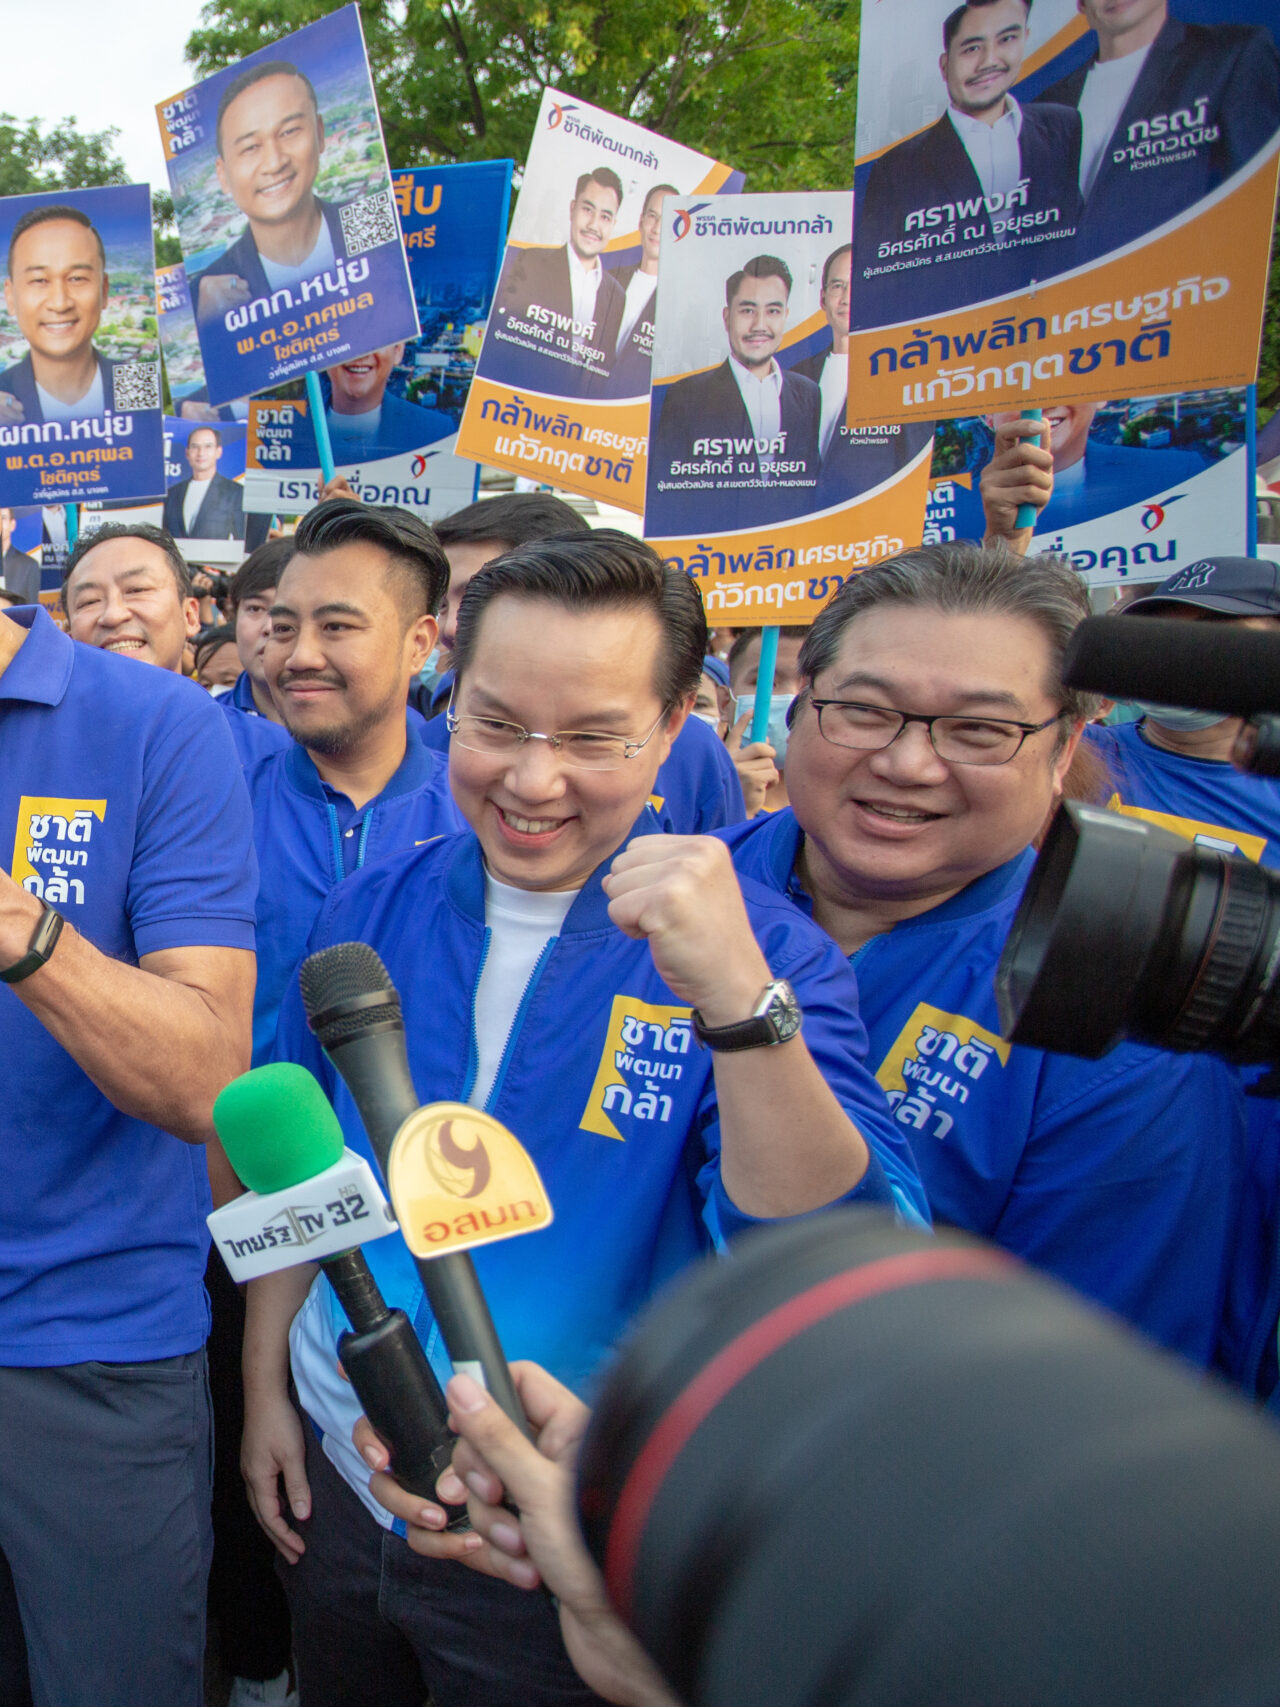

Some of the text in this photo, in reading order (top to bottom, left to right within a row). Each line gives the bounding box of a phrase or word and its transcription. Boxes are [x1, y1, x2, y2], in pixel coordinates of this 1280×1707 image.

[1127, 96, 1209, 142] กรณ์
[169, 125, 204, 153] กล้า
[563, 120, 659, 170] ชาติพัฒนากล้า
[1113, 125, 1220, 163] จาติกวณิช
[1130, 149, 1197, 171] หัวหน้าพรรค
[904, 178, 1031, 232] ศราพงศ์
[403, 225, 437, 248] ศรี
[695, 214, 833, 237] ชาติพัฒนากล้า
[878, 206, 1060, 258] อิศรศักดิ์ ณ อยุธยา
[225, 258, 370, 332] ผกก.หนุ่ย
[237, 292, 375, 355] พ.ต.อ.ทศพล
[526, 304, 597, 341] ศราพงศ์
[556, 335, 570, 349] ณ
[571, 341, 605, 363] อยุธยา
[902, 320, 1174, 407] แก้วิกฤตชาติ
[256, 404, 294, 425] ชาติ
[256, 425, 293, 439] พัฒนา
[480, 395, 649, 458] กล้าพลิกเศรษฐกิ
[6, 446, 134, 470] พ.ต.อ.ทศพล
[255, 439, 291, 461] กล้า
[494, 433, 635, 484] แก้วิกฤตชาติ
[692, 432, 787, 456] ศราพงศ์
[670, 456, 807, 477] อิศรศักดิ์ ณ อยุธยา
[29, 811, 93, 842] ชาติ
[26, 841, 88, 866] พัฒนา
[22, 866, 85, 905] กล้า
[621, 1015, 692, 1054] ชาติ
[916, 1026, 995, 1080] ชาติ
[615, 1047, 683, 1080] พัฒนา
[902, 1056, 970, 1104] พัฒนา
[602, 1080, 673, 1122] กล้า
[222, 1193, 370, 1258] ไทยรัฐ TV 32
[423, 1198, 538, 1243] อสมท
